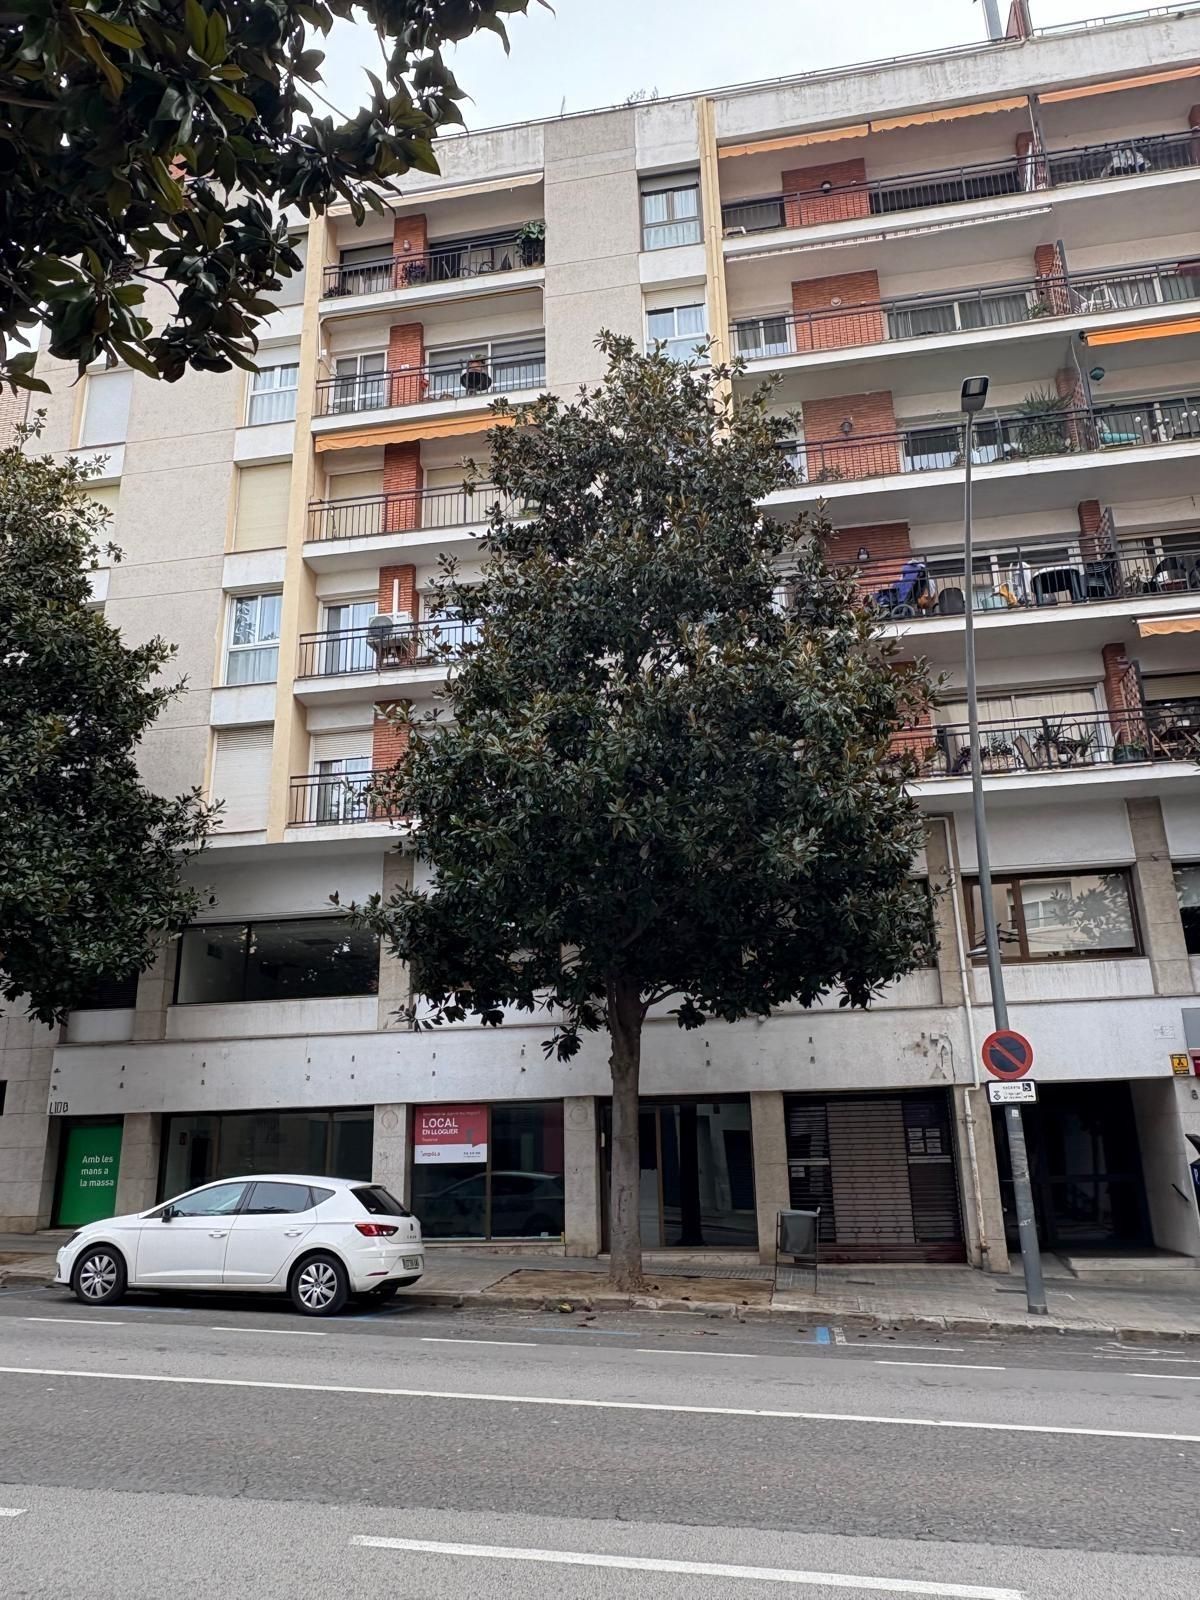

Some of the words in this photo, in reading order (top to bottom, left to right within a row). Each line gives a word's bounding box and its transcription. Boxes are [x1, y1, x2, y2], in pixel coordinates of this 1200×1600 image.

[422, 1117, 459, 1128] LOCAL
[82, 1155, 101, 1164] Amb
[101, 1155, 114, 1163] les
[89, 1179, 115, 1187] massa
